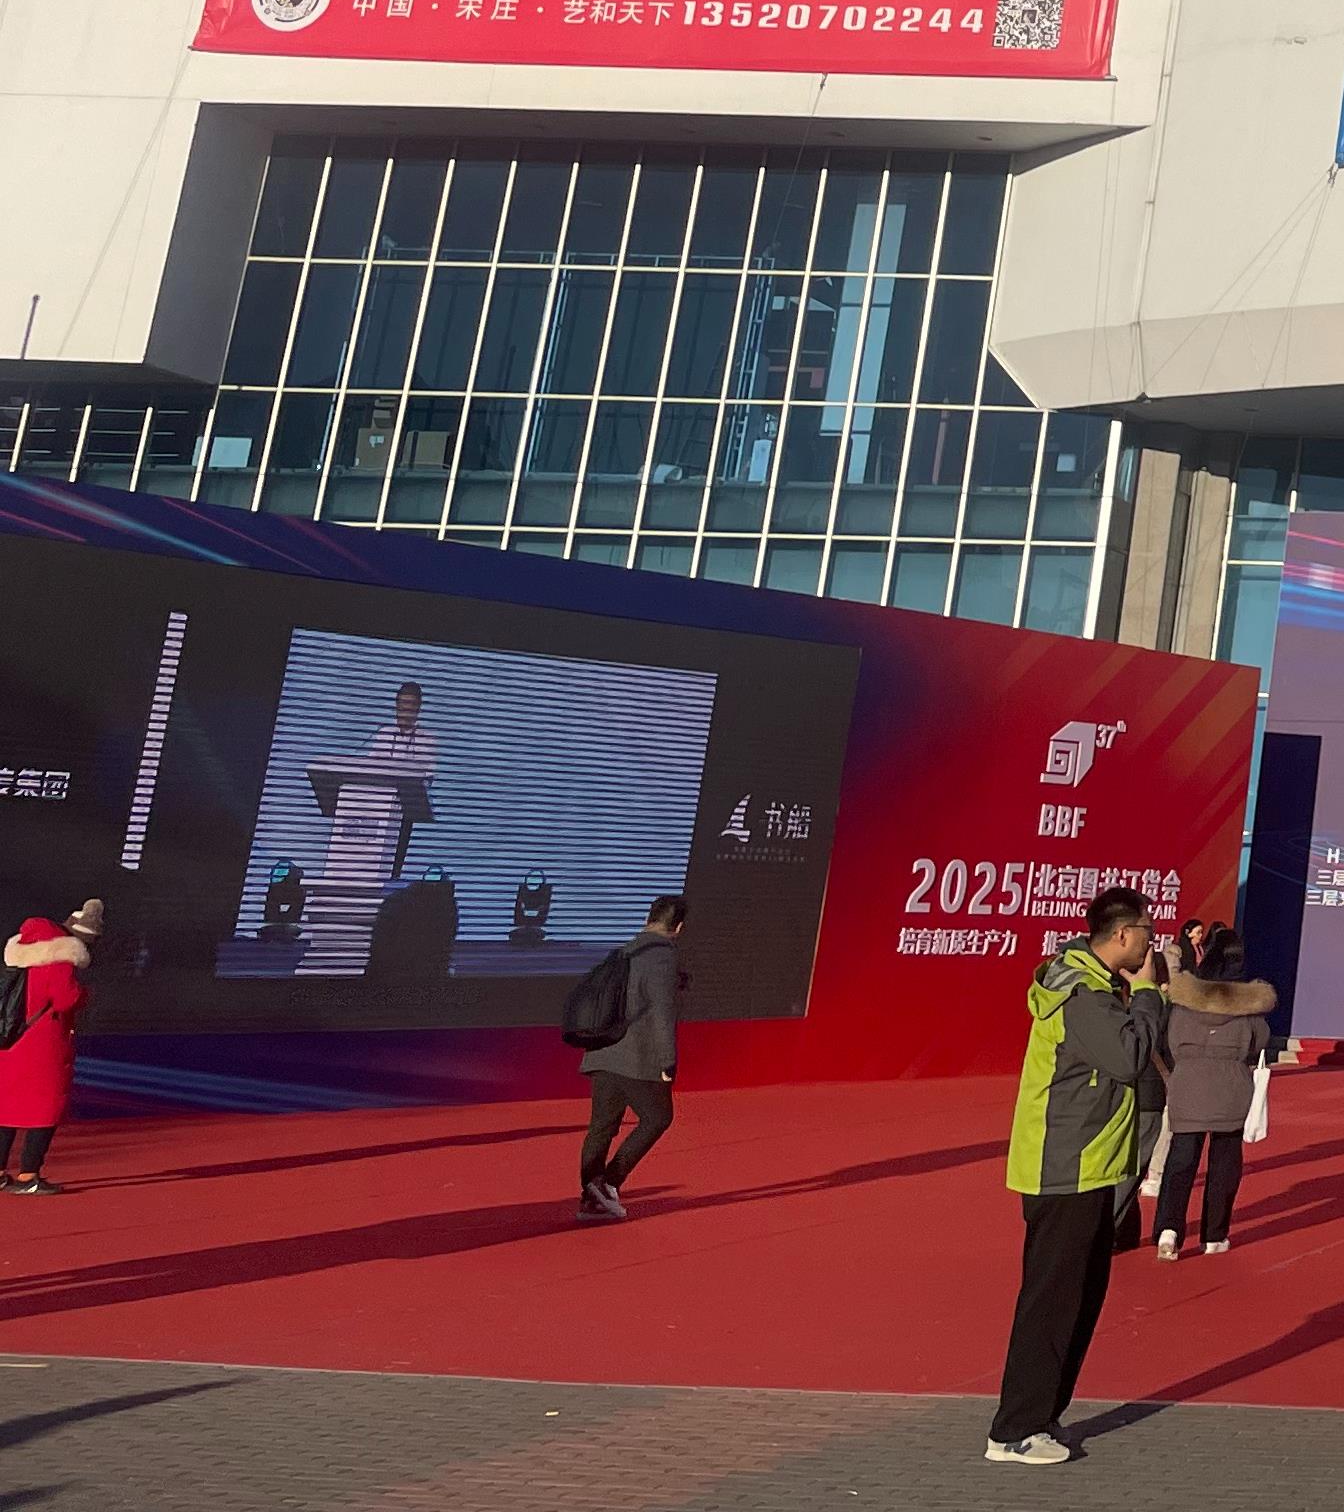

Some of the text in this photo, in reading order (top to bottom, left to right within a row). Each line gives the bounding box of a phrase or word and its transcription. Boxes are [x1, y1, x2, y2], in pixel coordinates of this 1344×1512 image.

[681, 0, 985, 34] 13520702244
[1038, 803, 1087, 839] BBF
[905, 858, 1026, 916] 2025
[1031, 899, 1088, 918] BEIJING
[897, 927, 1018, 956] 培育新质生产力
